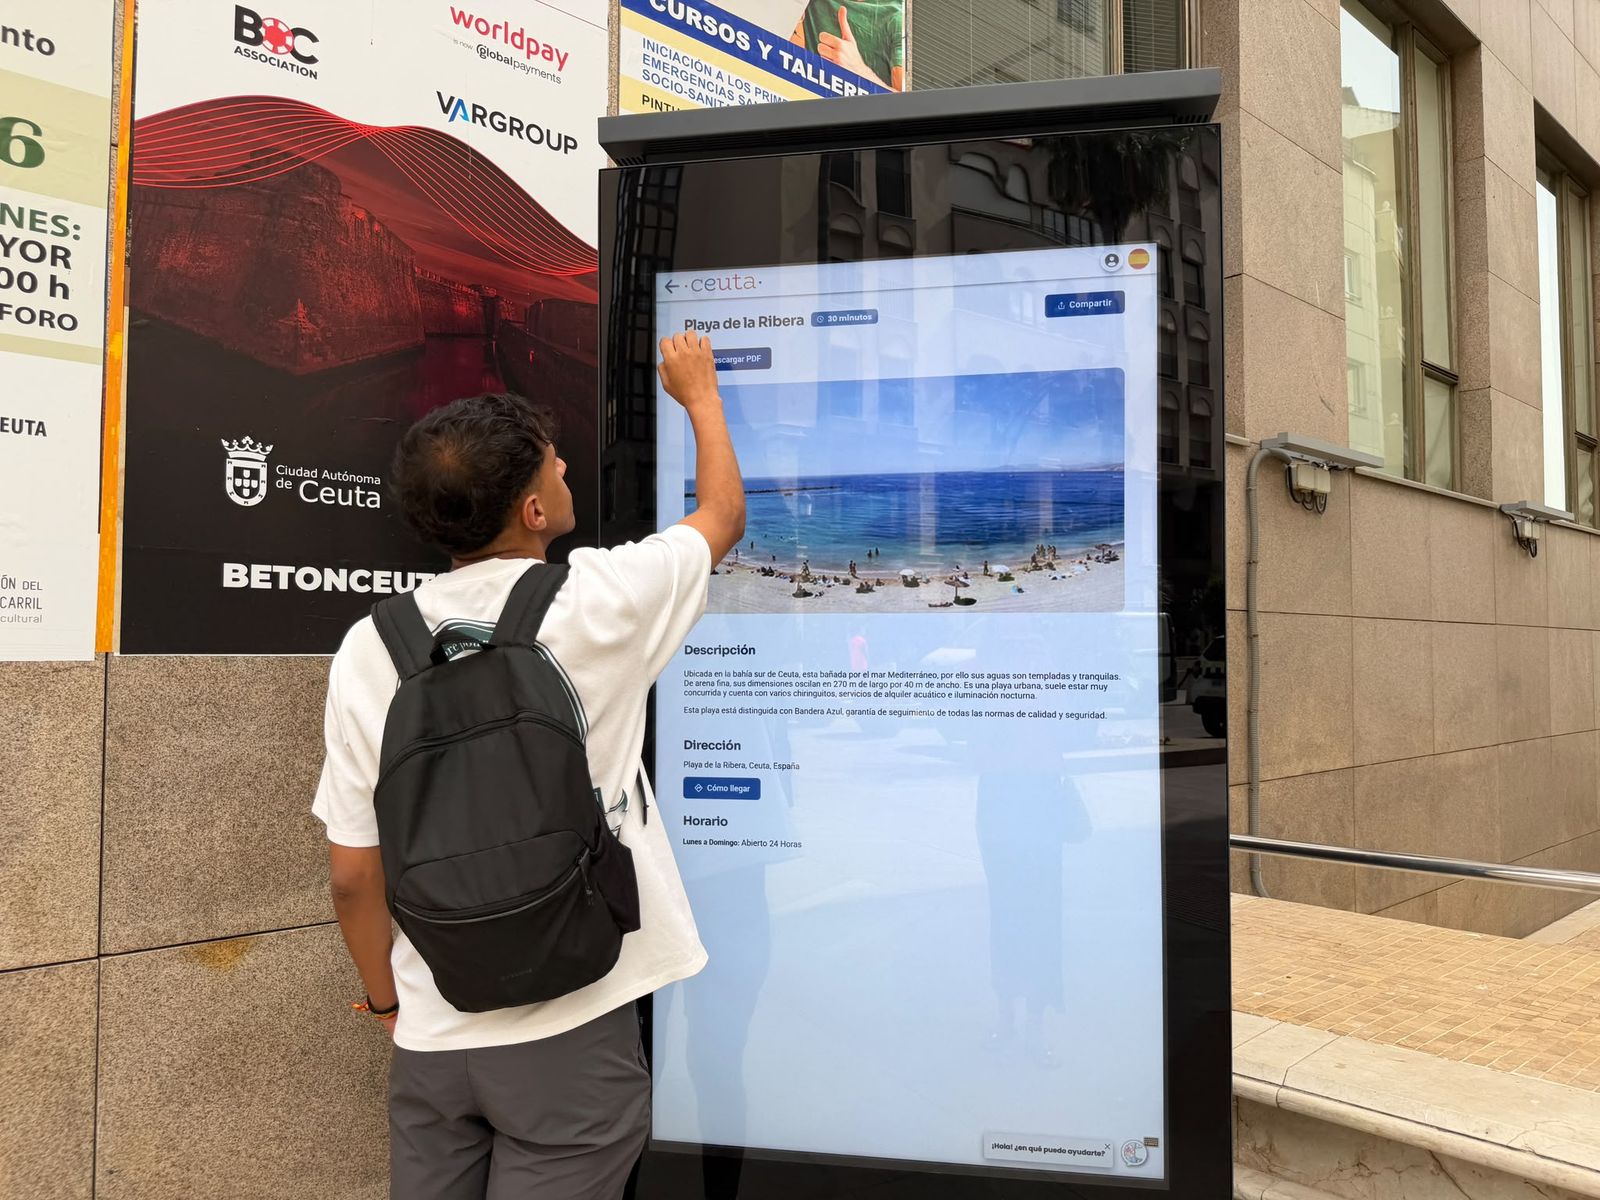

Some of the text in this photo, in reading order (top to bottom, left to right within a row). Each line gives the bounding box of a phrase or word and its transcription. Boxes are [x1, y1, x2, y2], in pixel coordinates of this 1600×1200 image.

[450, 6, 569, 72] worldpay
[649, 0, 751, 52] CURSOS
[757, 38, 774, 60] Y
[1, 24, 56, 56] nto
[234, 46, 318, 80] ASSOCIATION
[459, 40, 474, 50] now
[476, 44, 562, 84] globalpayments
[642, 37, 788, 104] INICIACIÓN A LOS PRIM
[642, 53, 758, 106] EMERGENCIAS SA
[642, 68, 730, 109] SOCIO-SANIT
[436, 90, 578, 154] VARGROUP
[0, 116, 45, 168] 6
[0, 202, 80, 241] NES:
[0, 234, 72, 270] YOR
[0, 266, 69, 300] 00 h
[1069, 299, 1112, 309] Compartir
[0, 302, 78, 331] FORO
[684, 315, 804, 333] Playa de la Ribera
[839, 313, 873, 322] minutos
[714, 354, 762, 365] escargar PDF
[0, 416, 47, 437] EUTA
[276, 464, 381, 485] Ciudad Autónoma
[276, 478, 381, 509] de Ceuta
[22, 580, 42, 590] DEL
[0, 596, 42, 610] CARRIL
[0, 614, 42, 623] cultural
[684, 644, 756, 657] Descripción
[888, 670, 939, 680] Mediterráneo,
[1028, 672, 1070, 680] templadas
[1079, 673, 1121, 681] tranquilas.
[716, 679, 732, 687] fina,
[869, 681, 888, 689] largo
[991, 682, 1012, 690] playa
[1014, 682, 1043, 690] urbana,
[1091, 684, 1108, 692] muy
[793, 690, 837, 698] chiringuitos,
[884, 690, 912, 699] alquiler
[955, 691, 998, 699] iluminación
[701, 706, 720, 715] playa
[738, 707, 778, 716] distinguida
[846, 708, 875, 717] garantía
[889, 709, 934, 717] seguimiento
[1065, 712, 1107, 720] seguridad.
[683, 740, 741, 751] Dirección
[683, 761, 703, 770] Playa
[723, 761, 747, 770] Ribera,
[749, 762, 772, 770] Ceuta,
[773, 762, 800, 771] España
[706, 784, 751, 794] Cómo llegar
[683, 815, 728, 826] Horario
[709, 839, 740, 847] Domingo:
